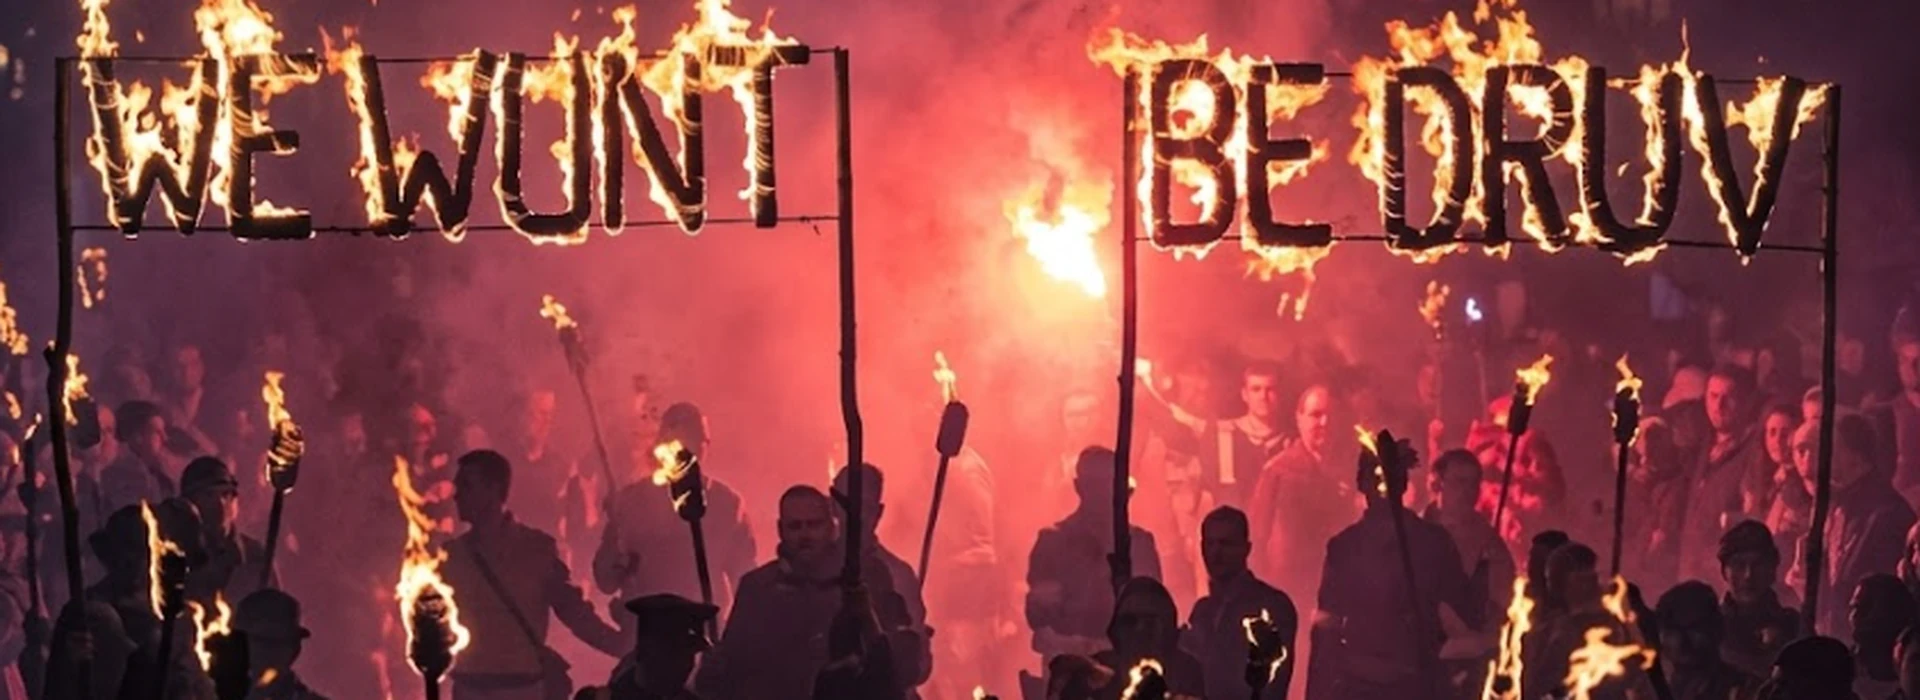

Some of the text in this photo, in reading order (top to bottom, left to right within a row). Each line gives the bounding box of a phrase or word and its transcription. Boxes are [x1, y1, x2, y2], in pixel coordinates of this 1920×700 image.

[88, 52, 317, 239] WE
[1146, 60, 1804, 256] BE DRUV
